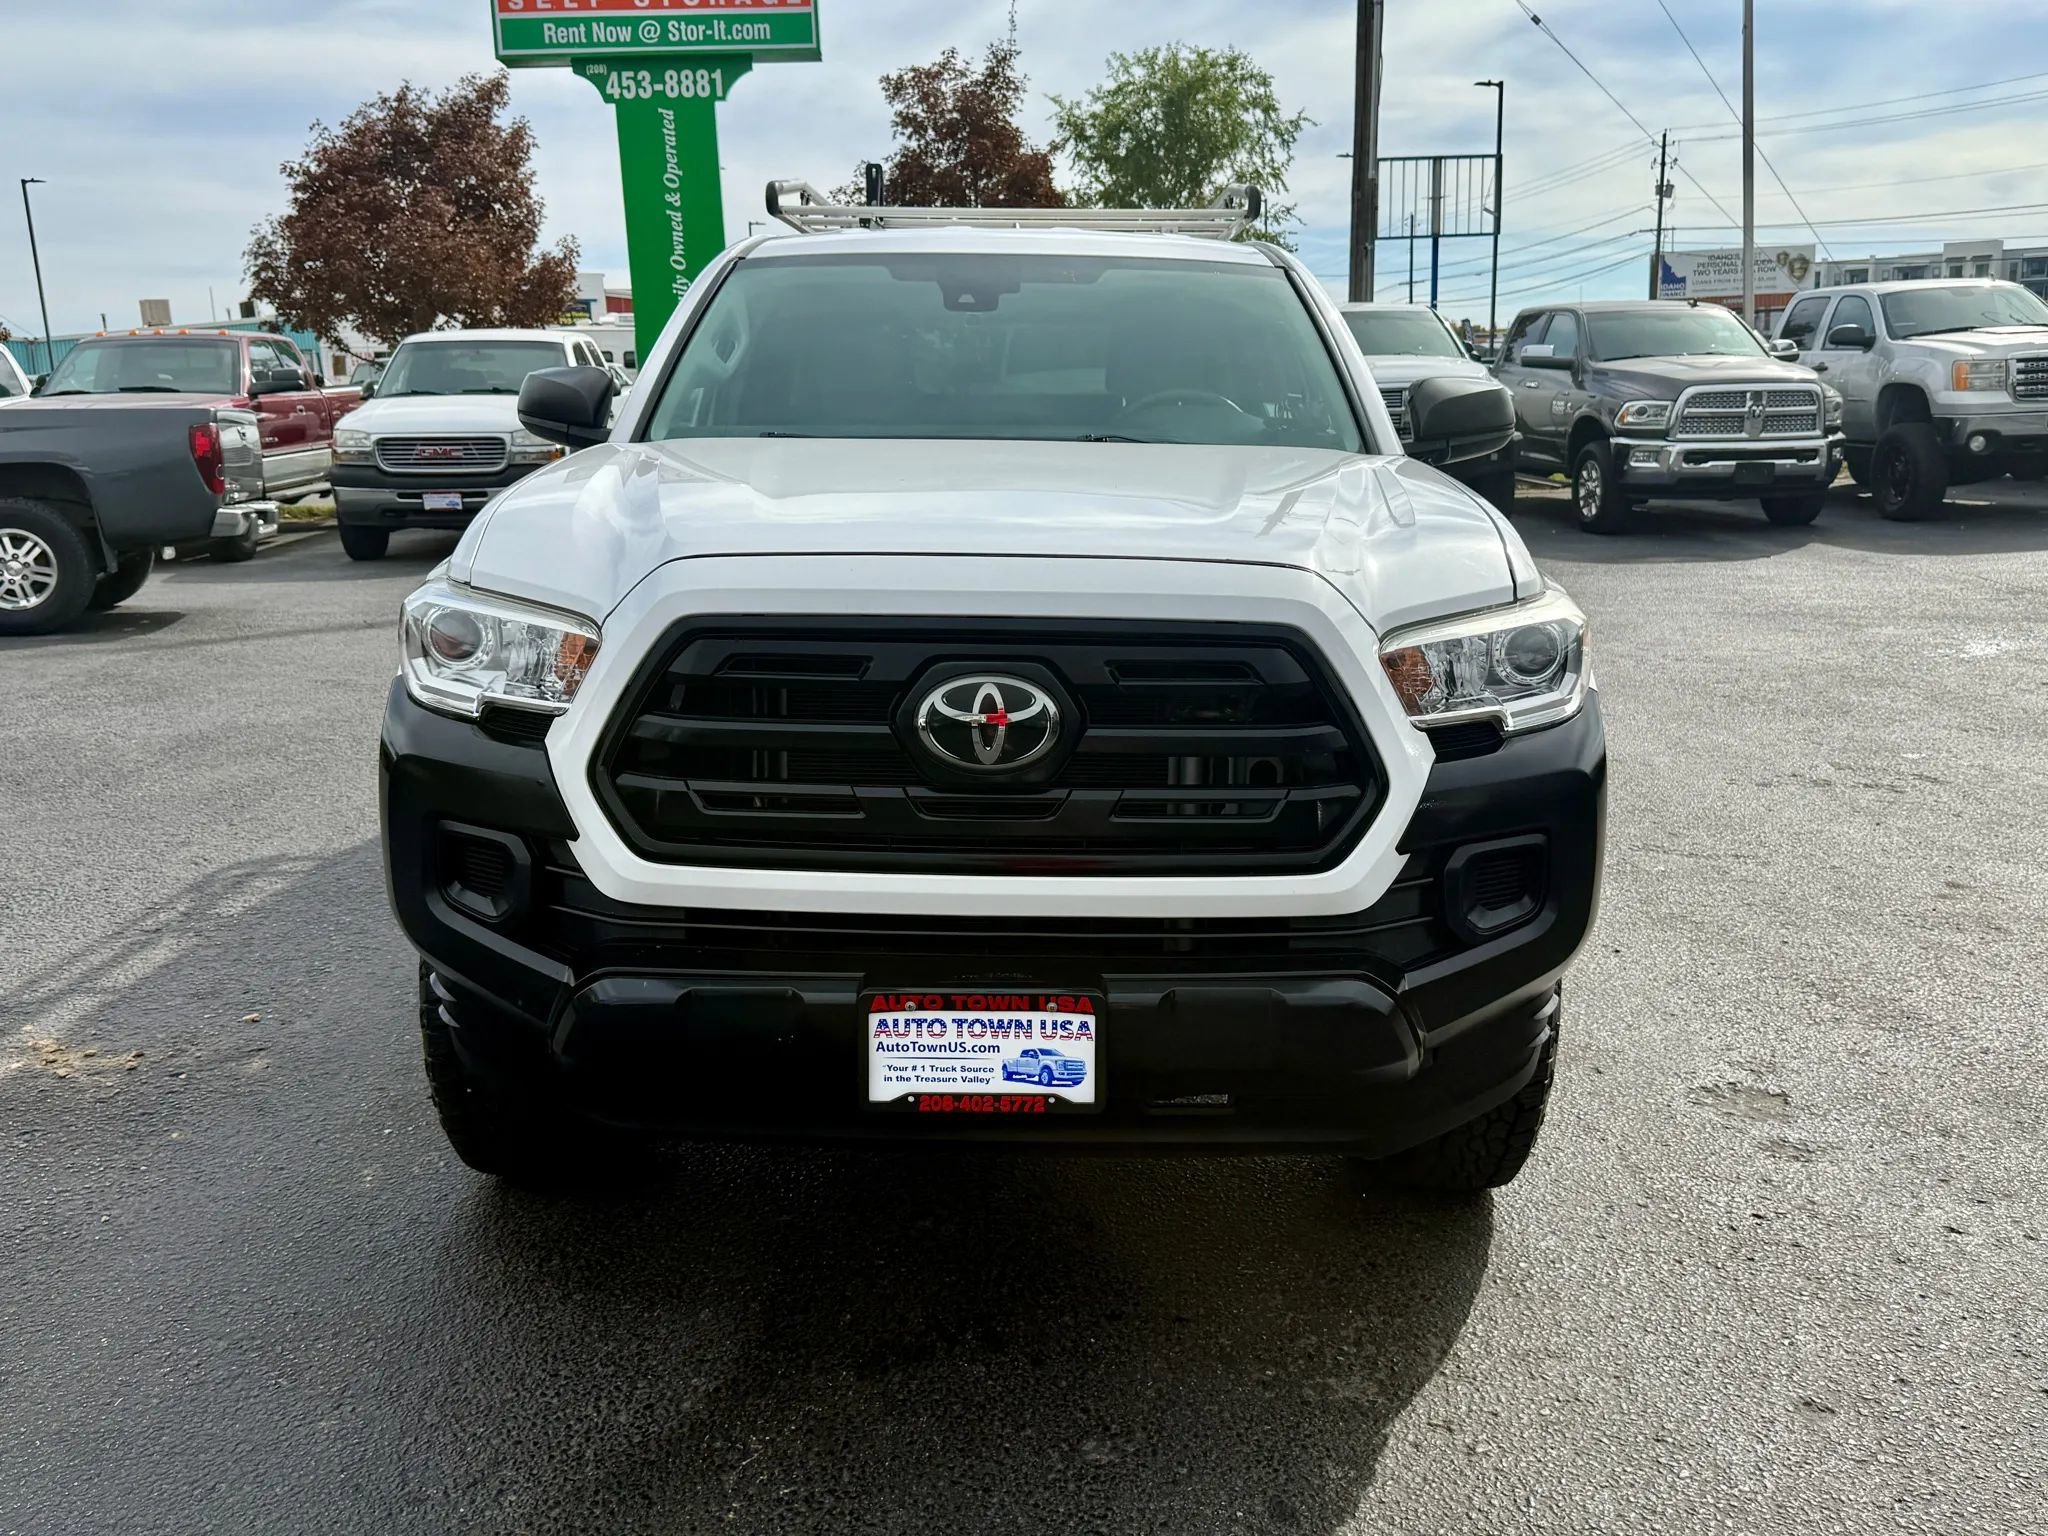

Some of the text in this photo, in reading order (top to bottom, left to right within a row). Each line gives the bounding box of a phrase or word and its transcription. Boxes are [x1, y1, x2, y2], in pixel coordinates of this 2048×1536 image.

[543, 19, 771, 44] Rent Now @ Stor-It.com
[605, 69, 724, 100] 453-8881
[657, 107, 692, 301] ily Owned & Operated
[1696, 260, 1739, 268] PERSONAL
[1693, 269, 1711, 277] TWO
[1757, 266, 1777, 274] ROW
[1660, 282, 1685, 290] IDAHO
[418, 446, 464, 457] GMC
[870, 994, 1093, 1013] AUTO TOWN USA
[873, 1018, 1094, 1041] AUTO TOWN USA
[876, 1041, 1000, 1054] AutoTownUS.com
[921, 1065, 926, 1073] 1
[929, 1065, 956, 1073] Truck
[960, 1065, 994, 1073] Source
[884, 1075, 892, 1083] in
[895, 1075, 911, 1083] the
[914, 1075, 957, 1083] Treasure
[919, 1096, 1045, 1112] 208-402-5772
